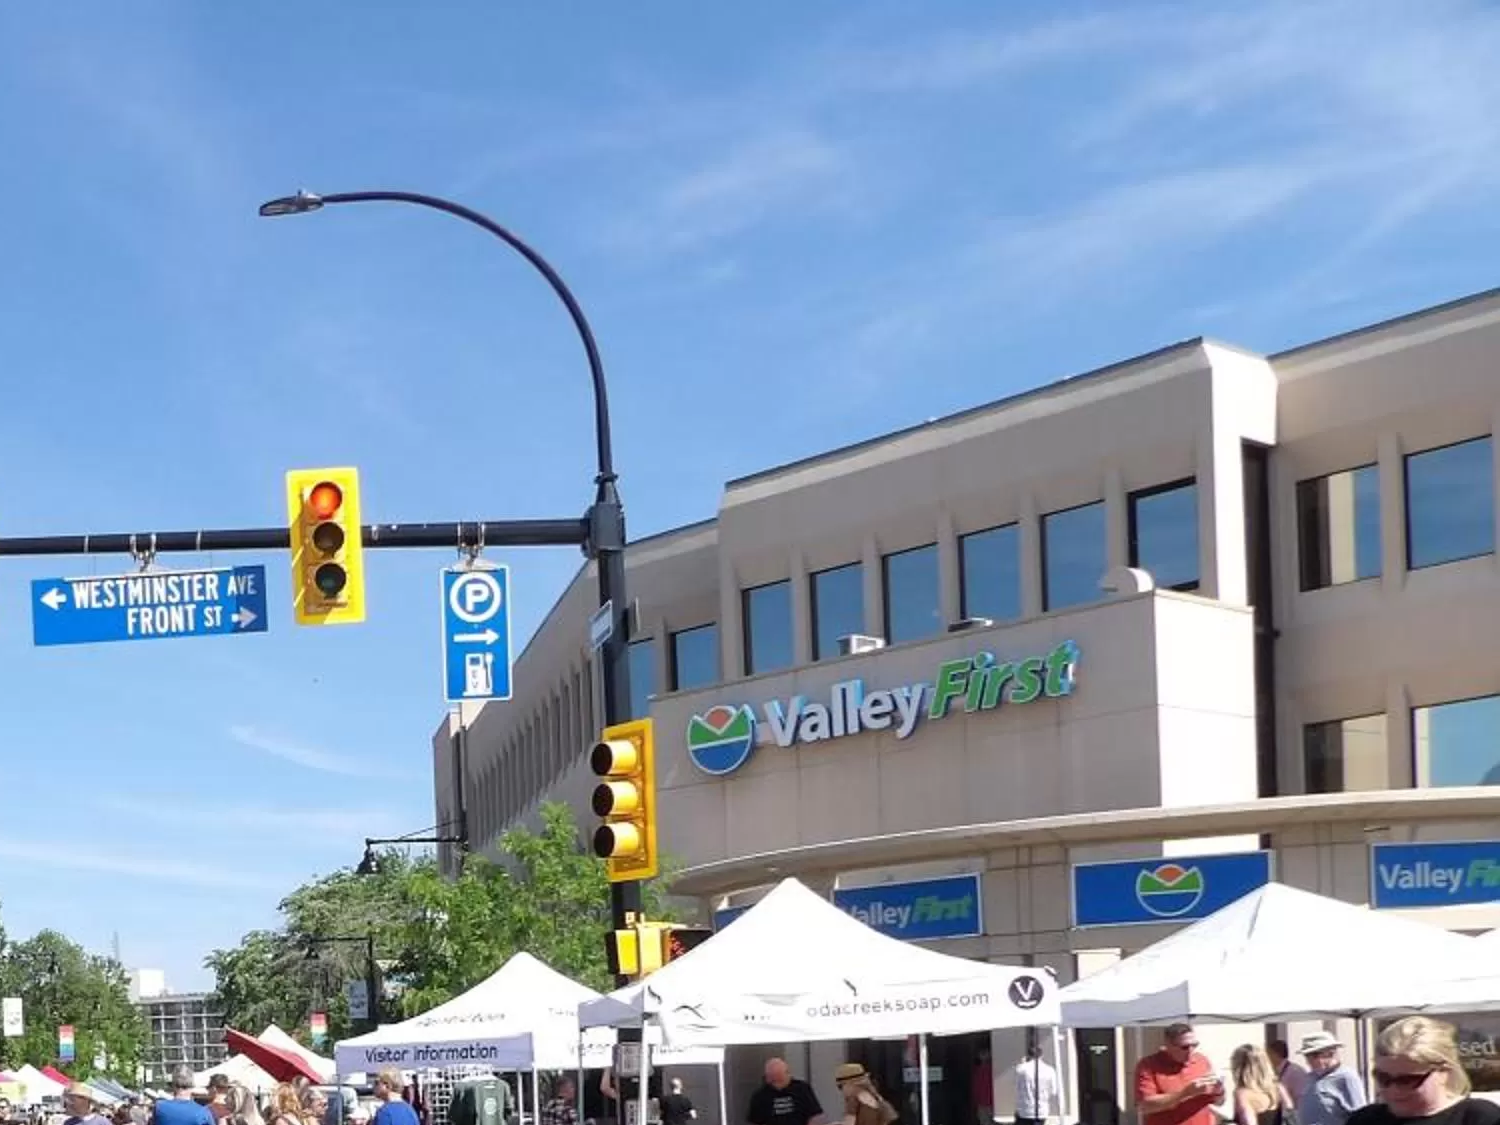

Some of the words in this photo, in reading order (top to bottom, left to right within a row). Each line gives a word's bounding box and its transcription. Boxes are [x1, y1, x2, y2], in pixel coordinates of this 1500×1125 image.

[71, 573, 218, 609] WESTMINSTER
[227, 574, 257, 597] AVE
[465, 583, 489, 611] P
[127, 604, 196, 635] FRONT
[203, 606, 223, 627] ST
[764, 679, 928, 748] Valley
[927, 639, 1080, 719] First
[1379, 860, 1464, 895] Valley
[806, 991, 990, 1018] odacreeksoap.com
[365, 1047, 408, 1063] Visitor
